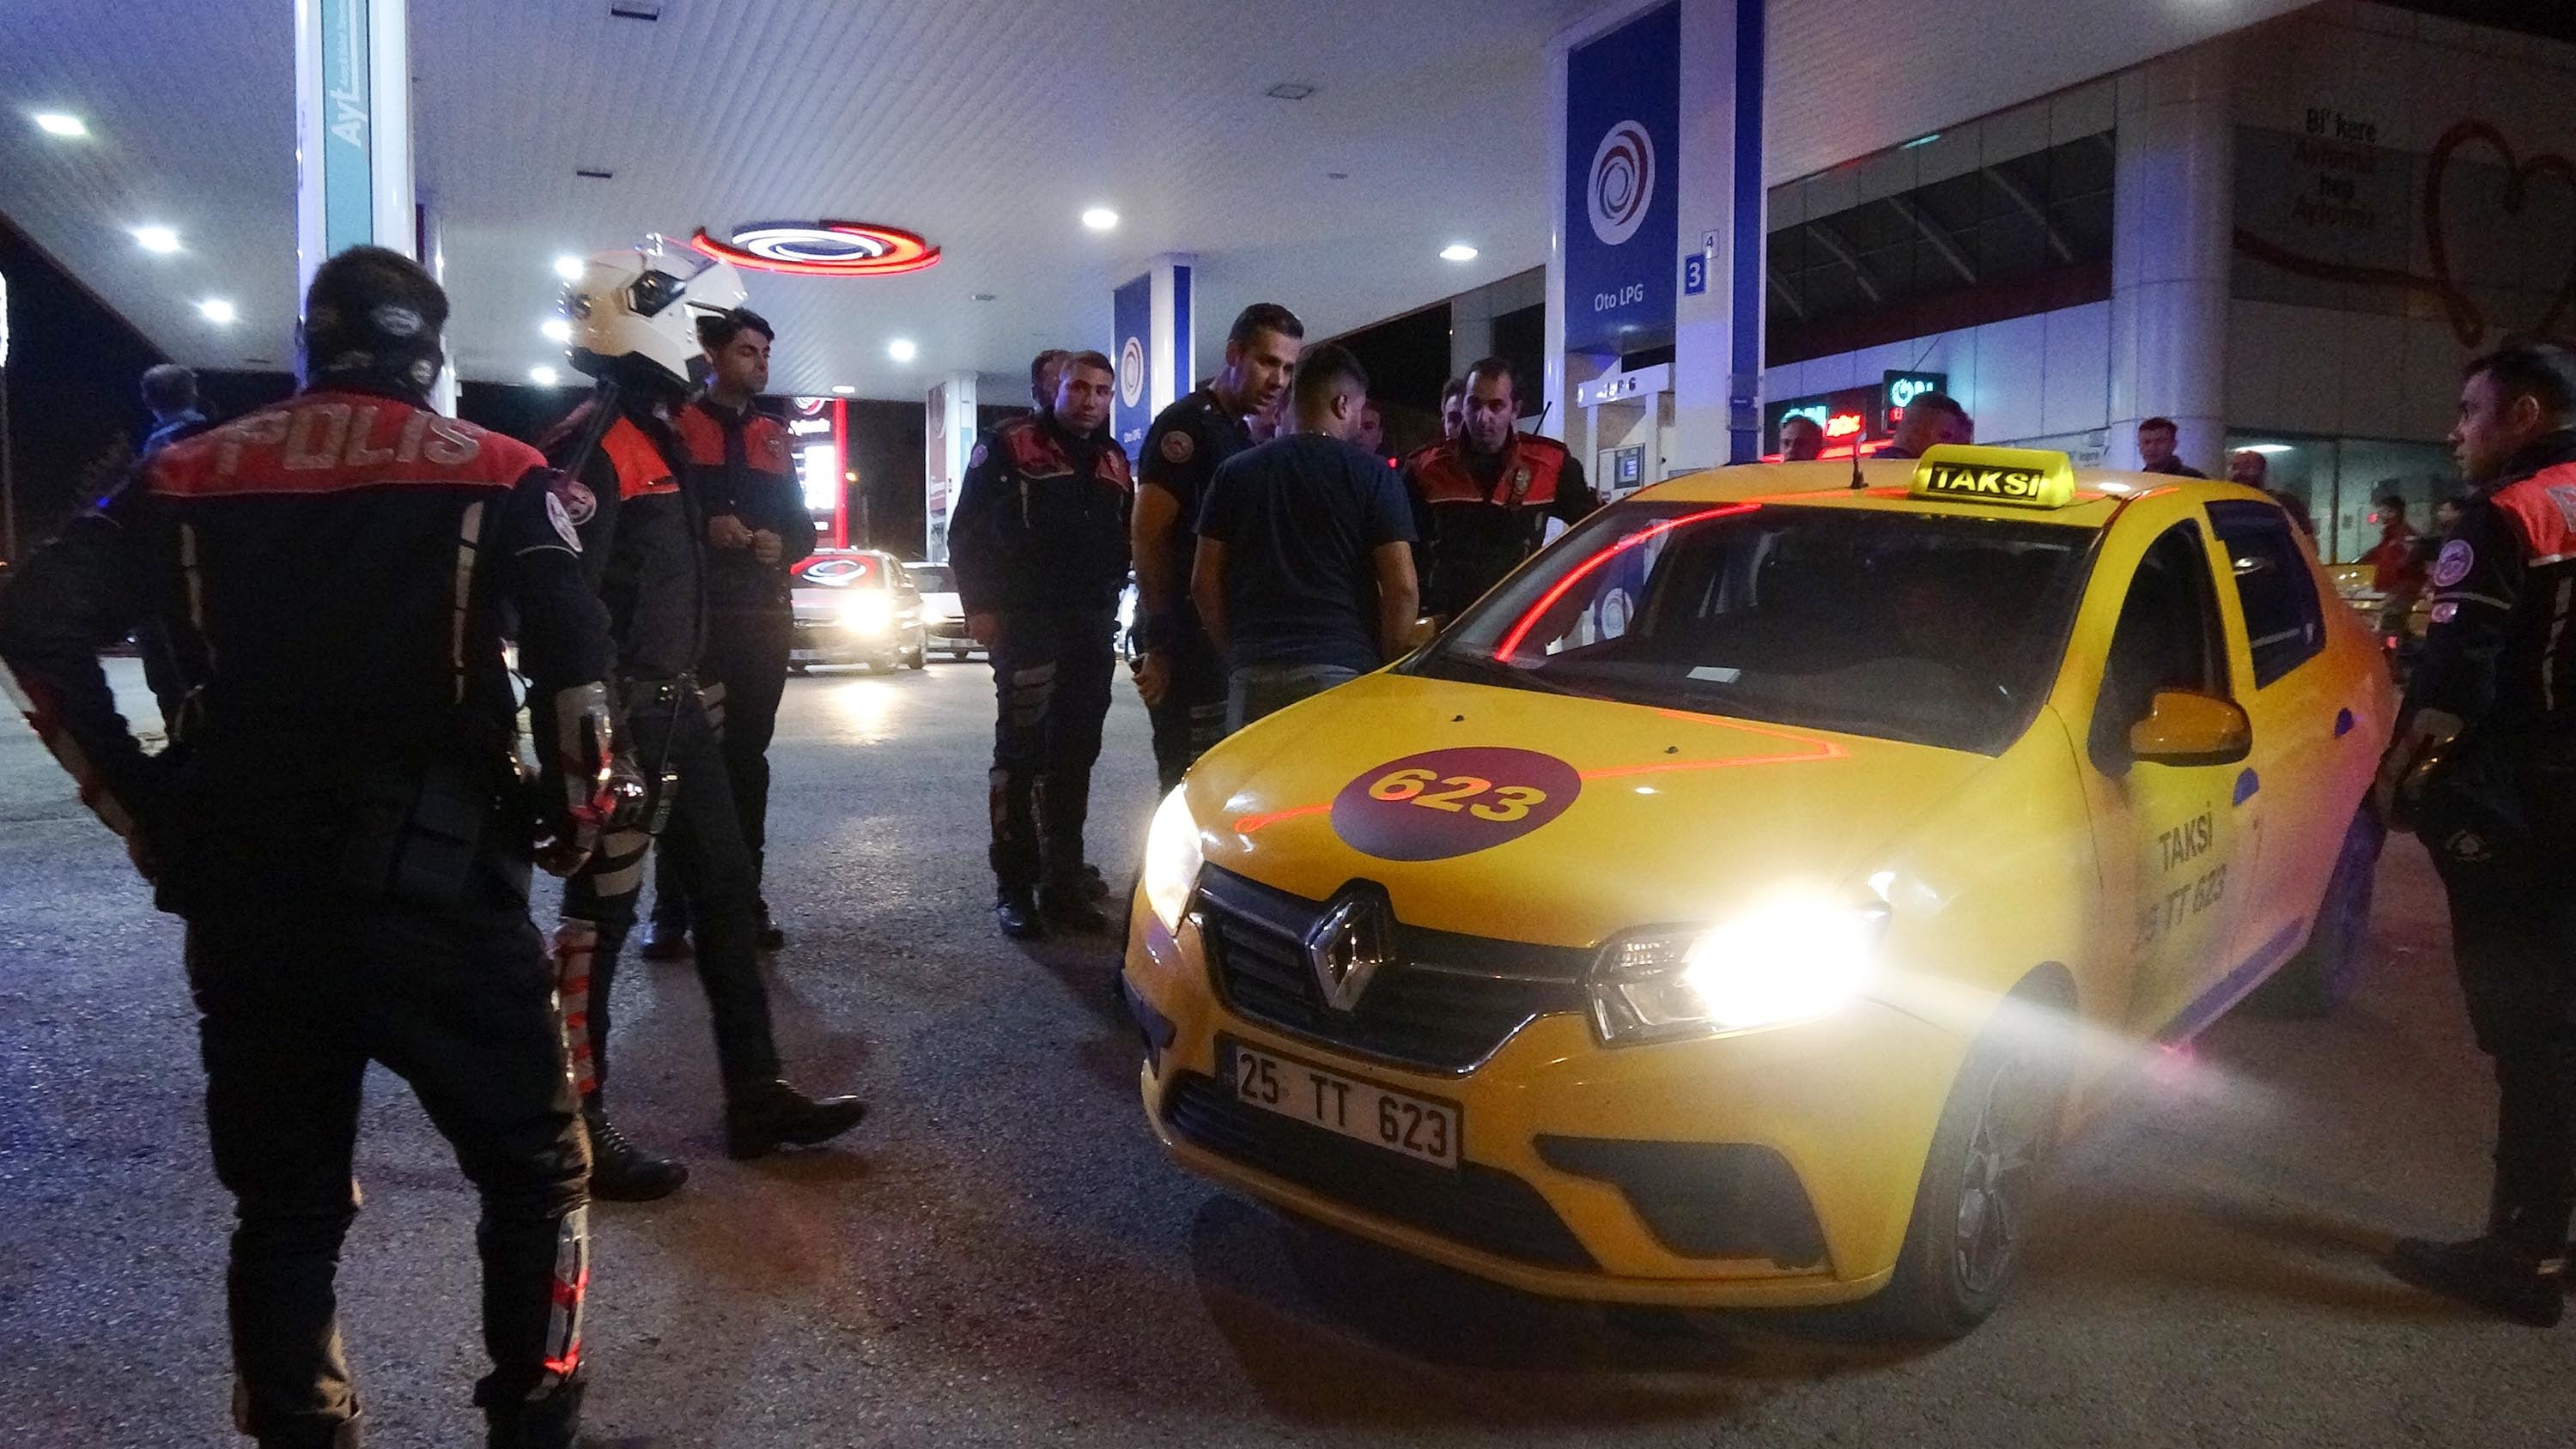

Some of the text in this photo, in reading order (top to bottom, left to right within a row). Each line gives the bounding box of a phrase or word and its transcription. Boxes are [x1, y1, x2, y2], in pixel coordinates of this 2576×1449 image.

[1705, 235, 1714, 248] 4
[1688, 261, 1701, 288] 3
[1595, 282, 1643, 312] Oto LPG
[1368, 768, 1547, 822] 623
[2165, 882, 2192, 934] TT
[2191, 862, 2228, 916] 623
[1239, 1052, 1448, 1159] 25 TT 623
